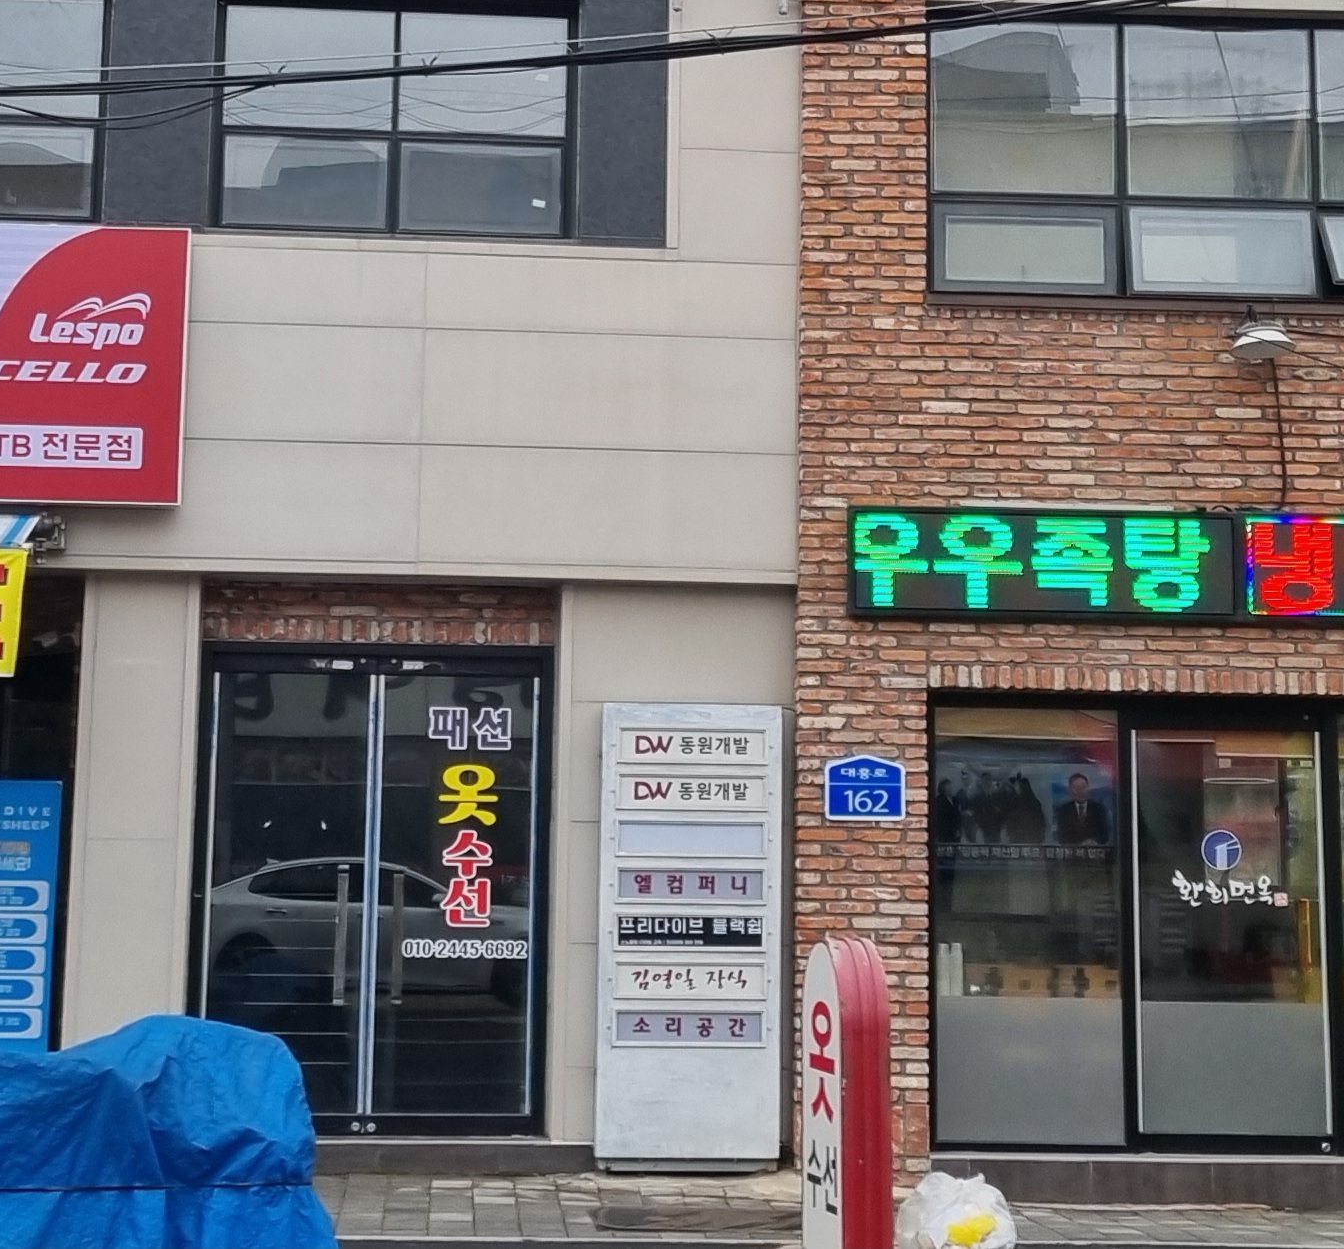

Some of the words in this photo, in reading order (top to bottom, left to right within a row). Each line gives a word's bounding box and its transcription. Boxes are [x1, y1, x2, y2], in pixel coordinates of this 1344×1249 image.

[29, 312, 145, 350] Lespo
[41, 430, 133, 463] 전문점
[854, 513, 1211, 612] 우우족탕
[429, 705, 512, 750] 패션
[634, 734, 674, 755] DW
[679, 734, 750, 756] 동원개발
[841, 767, 889, 779] 대흥로
[438, 764, 499, 826] 옷
[633, 781, 674, 801] DW
[678, 781, 750, 802] 동원개발
[843, 789, 890, 814] 162
[440, 829, 494, 928] 수선
[619, 917, 705, 936] 프리다이브
[402, 939, 528, 960] 010-2445-6692
